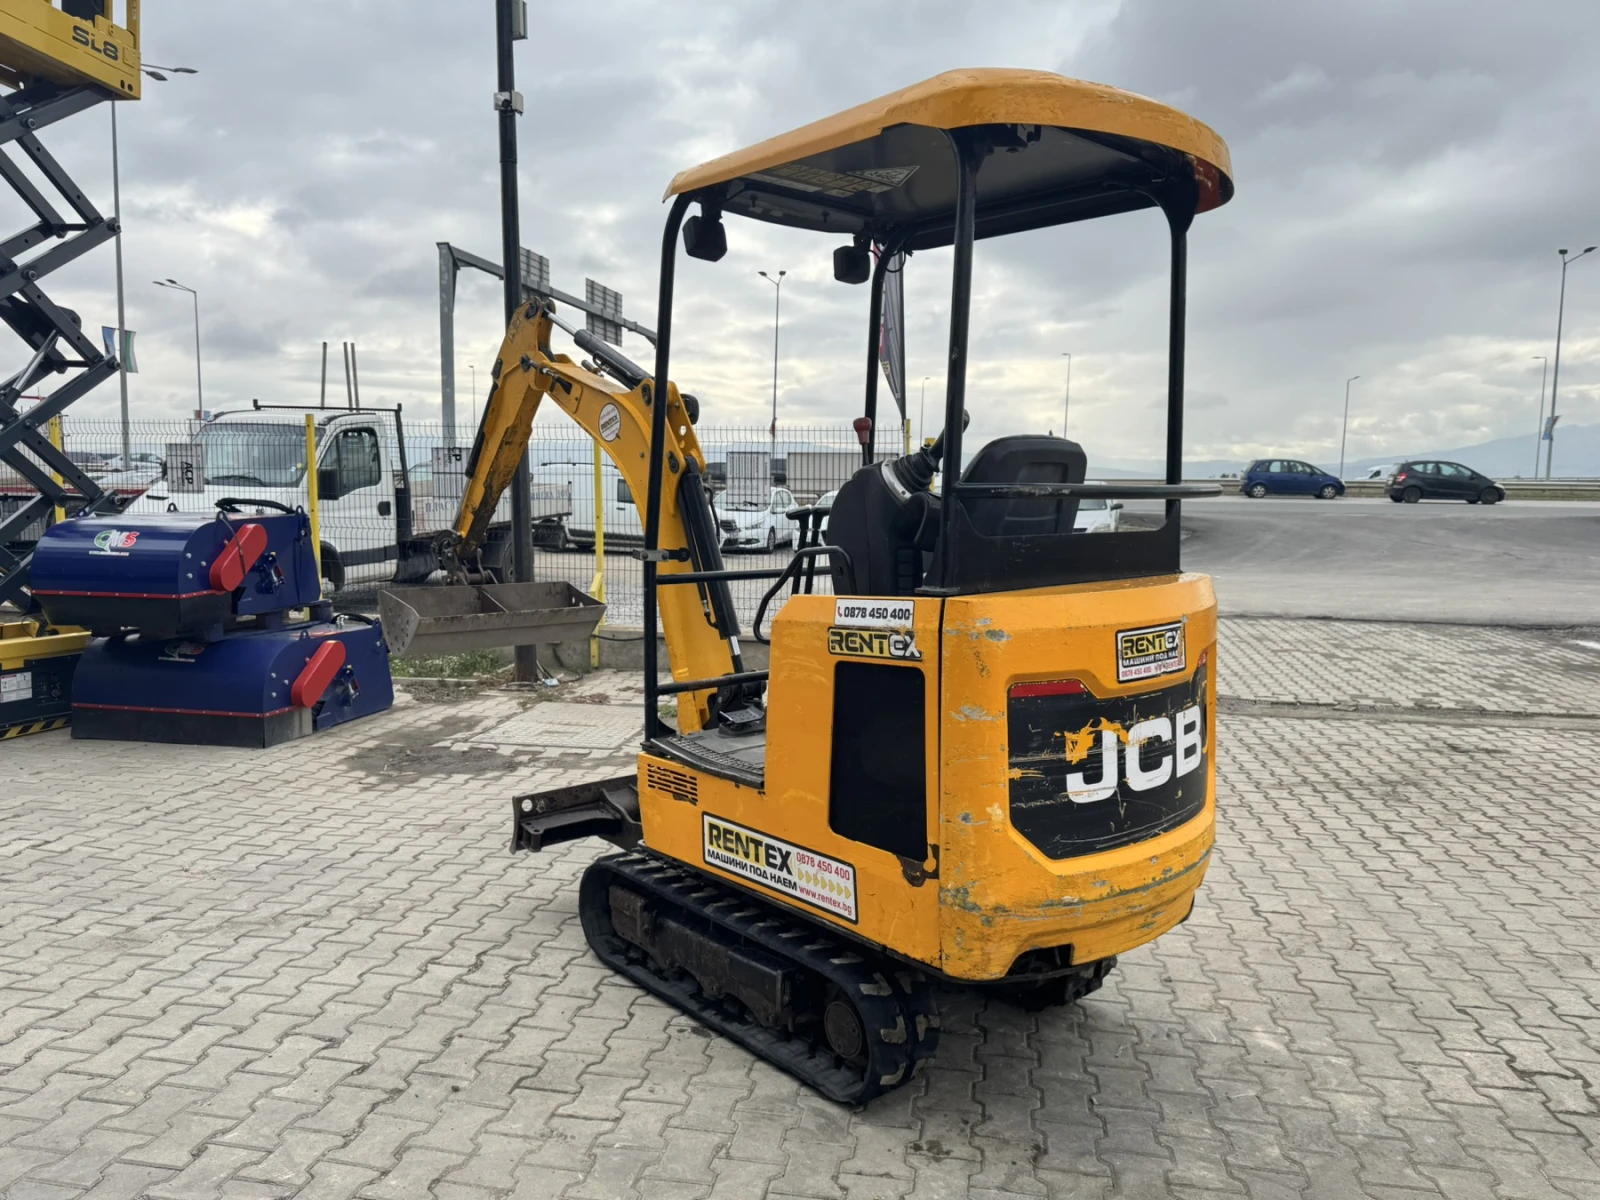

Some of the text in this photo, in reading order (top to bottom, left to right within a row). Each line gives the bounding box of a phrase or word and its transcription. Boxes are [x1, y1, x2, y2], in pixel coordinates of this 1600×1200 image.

[72, 25, 118, 61] SL8
[843, 606, 911, 620] 0878 450 400
[830, 630, 921, 658] RENTEX
[1123, 655, 1155, 666] МАШИНИ
[1155, 652, 1168, 660] ПОД
[1066, 704, 1202, 804] JCB
[708, 822, 794, 876] RENTEX
[707, 848, 798, 892] МАШИНИ ПОД НАЕМ
[796, 851, 851, 881] 0878 450 400
[798, 885, 853, 916] www.rentex.bg
